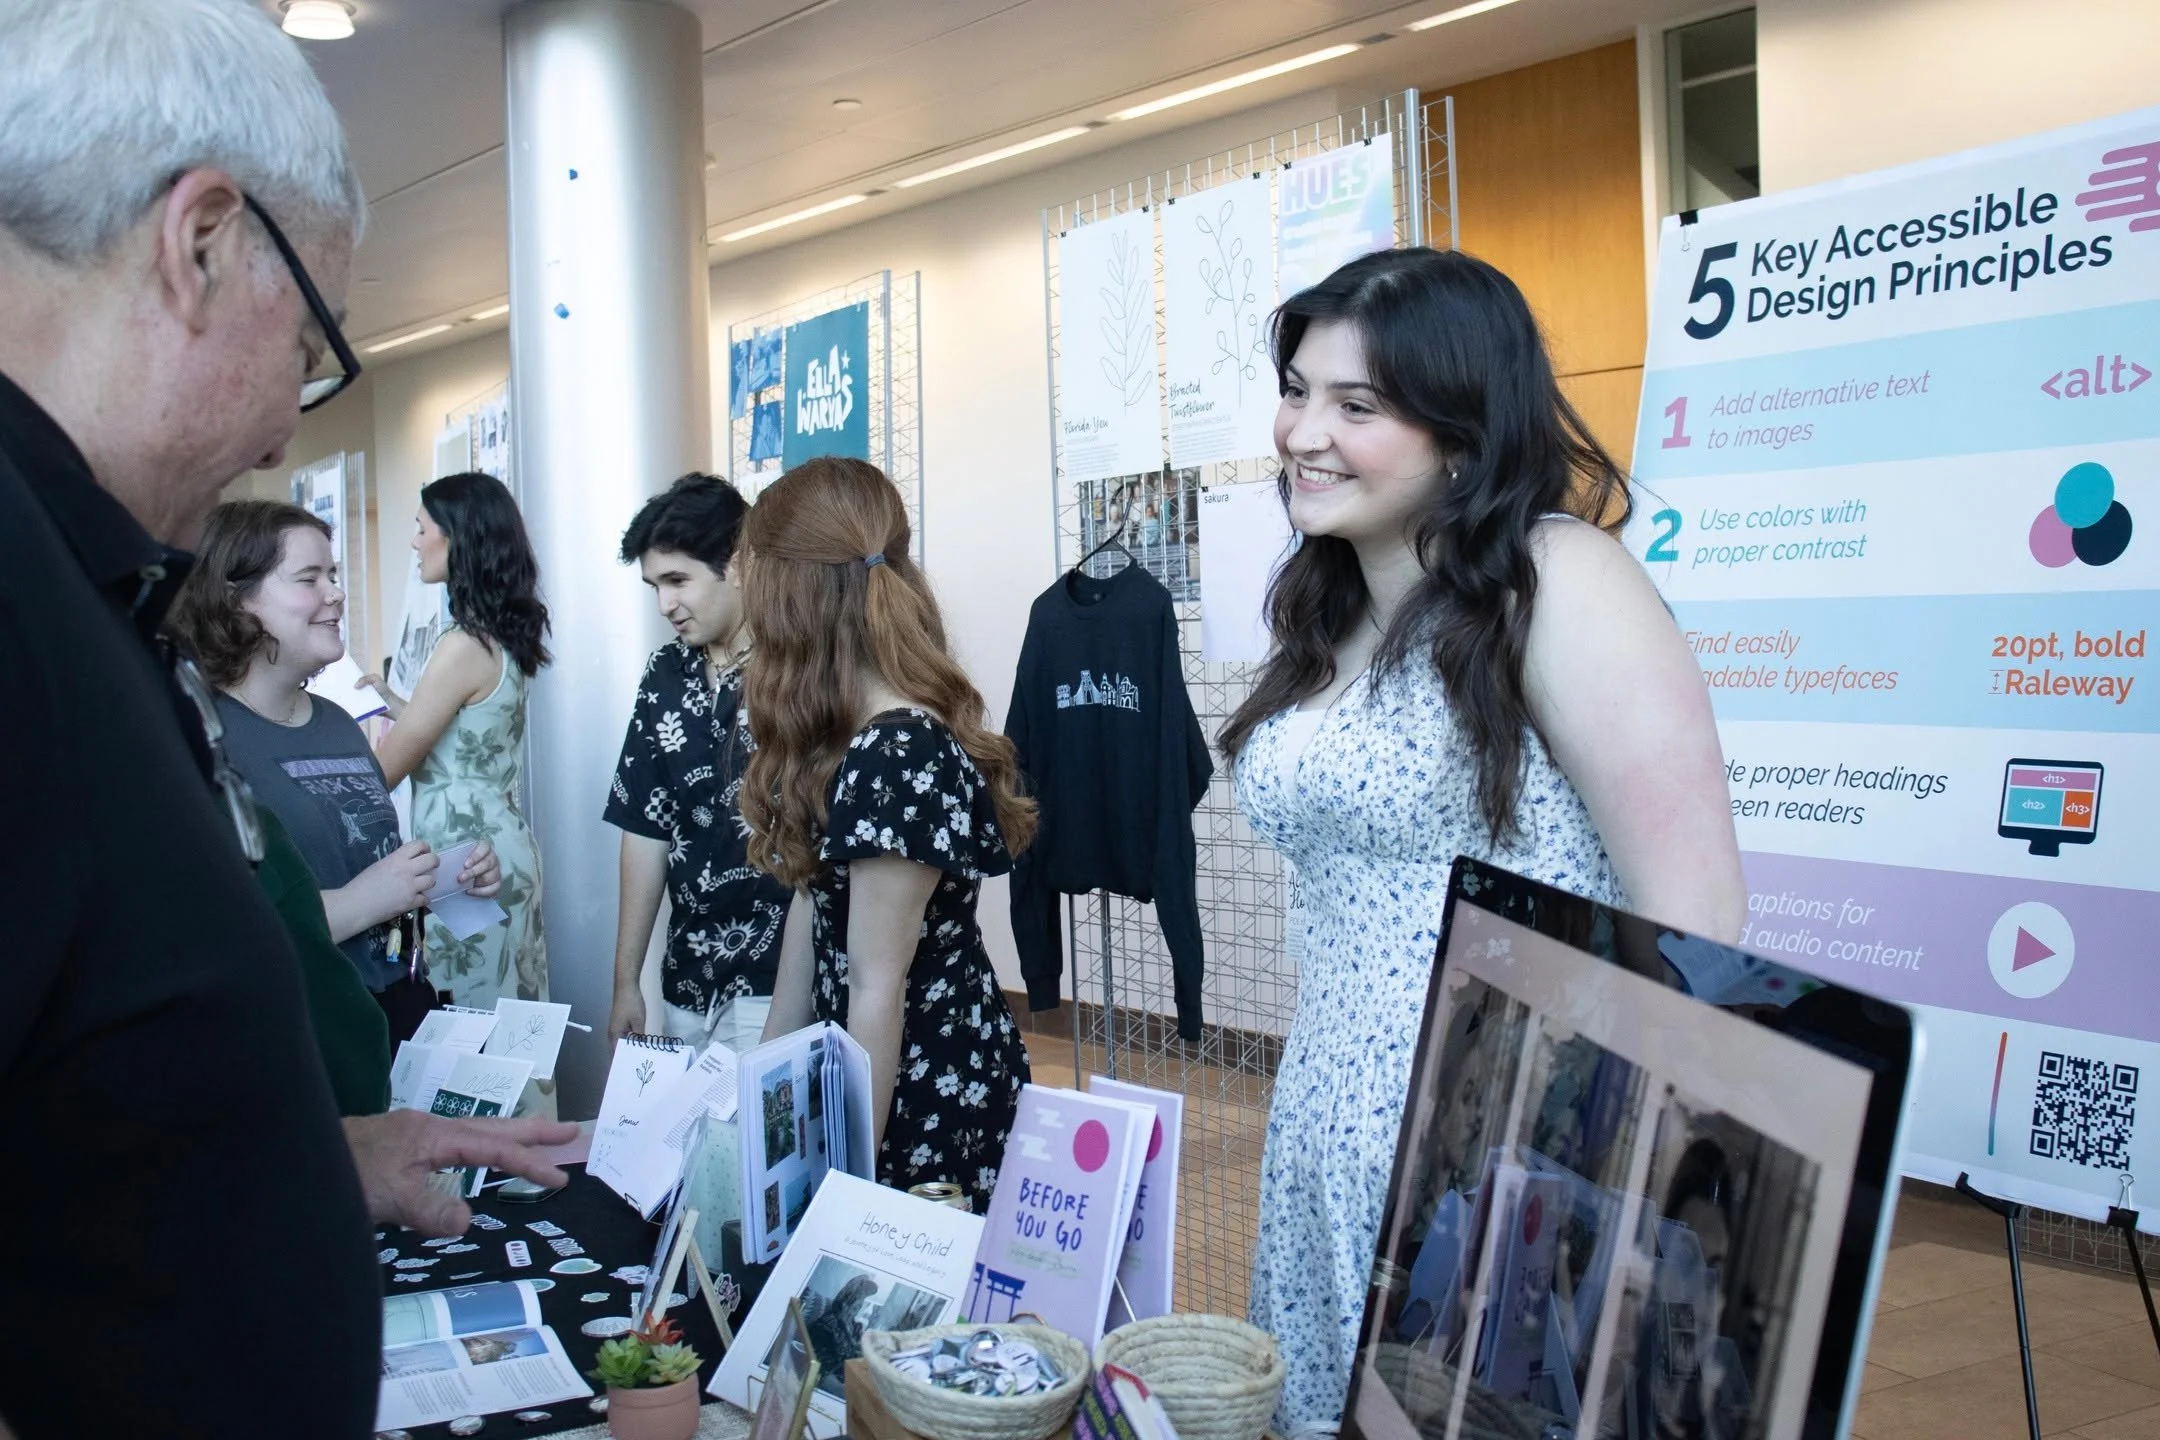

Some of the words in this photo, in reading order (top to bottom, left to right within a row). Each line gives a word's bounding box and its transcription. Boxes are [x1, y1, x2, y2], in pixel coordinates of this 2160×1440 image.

[1281, 150, 1372, 214] HUES
[1750, 239, 1818, 278] Key
[1826, 188, 2058, 262] Accessible
[1683, 241, 1738, 340] 5
[1747, 275, 1876, 323] Design
[1889, 233, 2113, 300] Principles
[1710, 391, 1755, 416] Add
[1761, 375, 1880, 411] alternative
[1886, 370, 1930, 396] text
[2041, 354, 2152, 401] <alt>
[1661, 396, 1692, 449] 1
[1707, 429, 1728, 450] to
[1733, 420, 1814, 451] images
[1203, 492, 1230, 505] sakura
[1700, 508, 1740, 531] Use
[1746, 504, 1815, 529] colors
[1821, 499, 1867, 524] with
[1645, 509, 1682, 562] 2
[1692, 537, 1768, 569] proper
[1773, 533, 1867, 561] contrast
[1734, 629, 1801, 660] easily
[1991, 630, 2065, 664] 20pt,
[2074, 629, 2145, 659] bold
[1702, 664, 1779, 689] adable
[1783, 662, 1899, 695] typefaces
[2004, 669, 2134, 705] Raleway
[1749, 763, 1830, 791] proper
[1833, 762, 1949, 800] headings
[2041, 772, 2067, 786] <h1>
[1774, 798, 1866, 826] readers
[2020, 798, 2046, 811] <h2>
[2064, 801, 2091, 817] <h3>
[1747, 892, 1834, 922] aptions
[1836, 897, 1876, 929] for
[1755, 928, 1822, 957] audio
[1827, 940, 1925, 971] content
[1018, 1176, 1090, 1221] BEFORE
[859, 1210, 912, 1250] Honey
[914, 1232, 955, 1258] Child
[1015, 1210, 1048, 1240] YOU
[1056, 1220, 1083, 1252] GO
